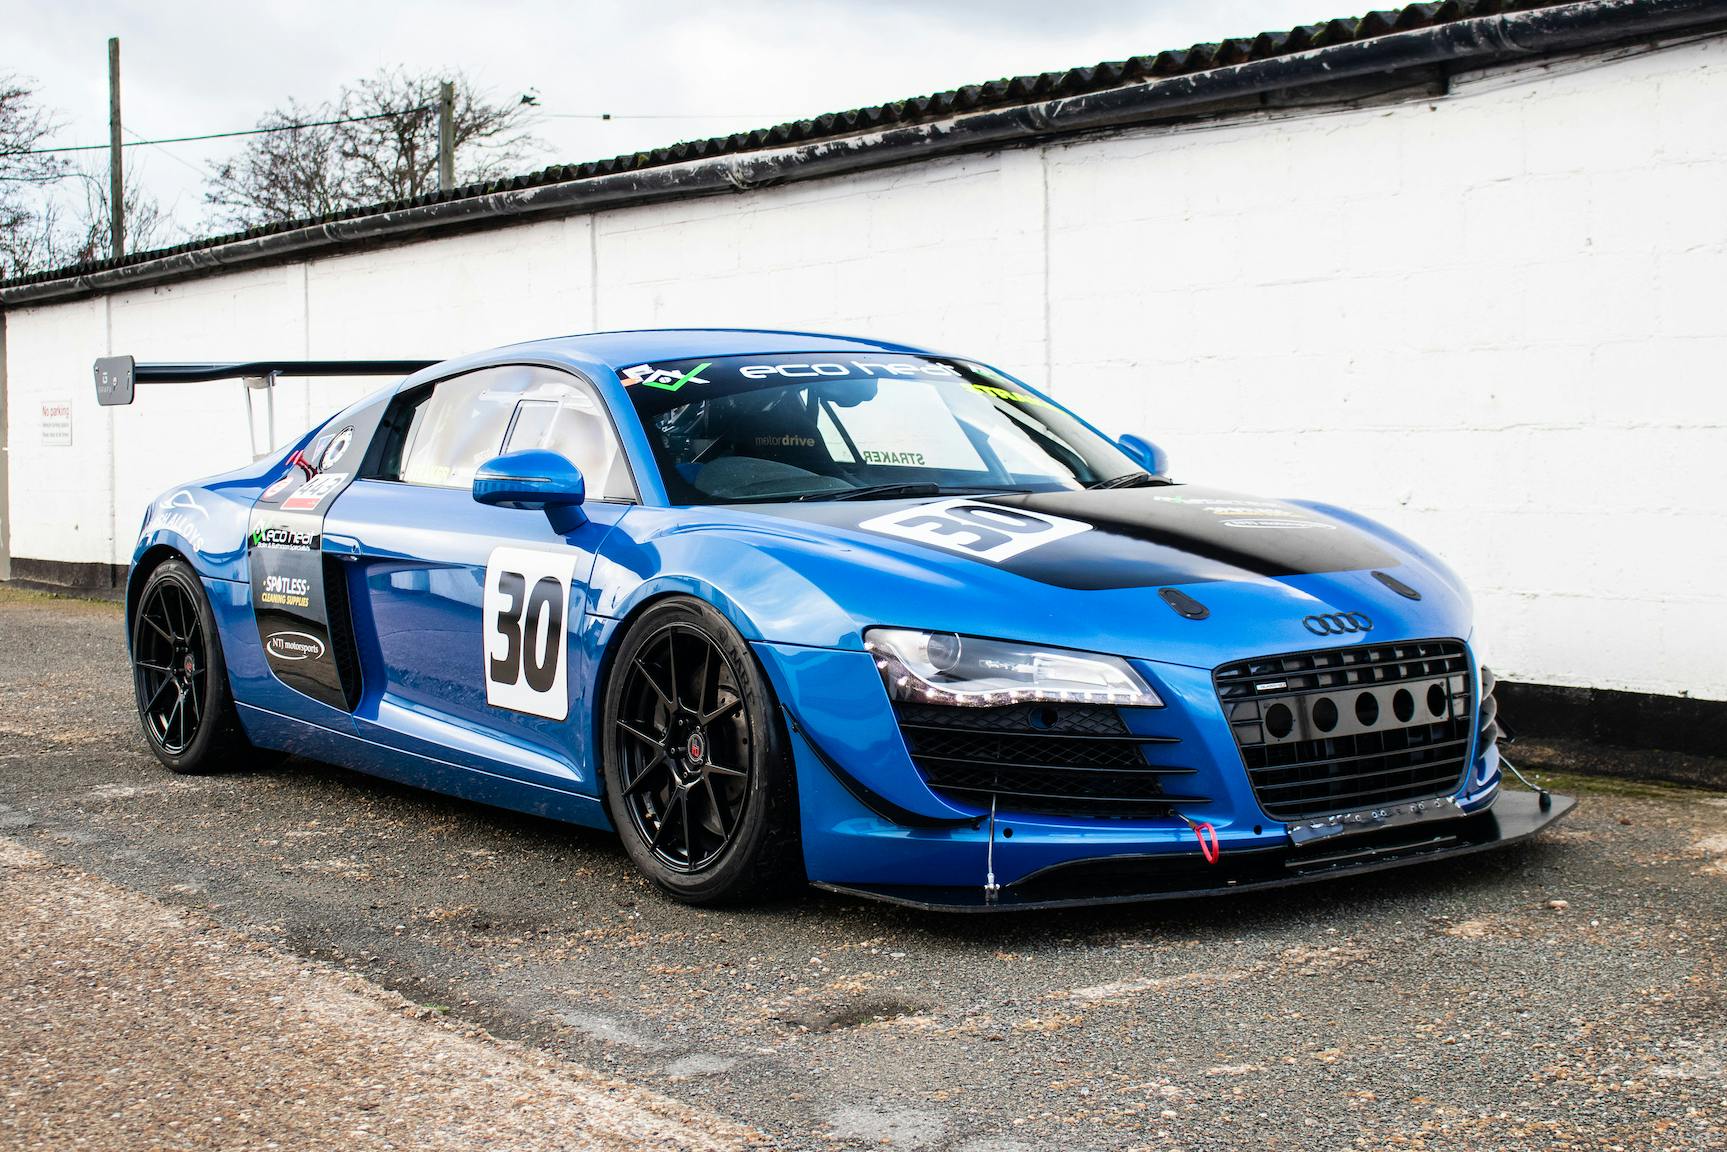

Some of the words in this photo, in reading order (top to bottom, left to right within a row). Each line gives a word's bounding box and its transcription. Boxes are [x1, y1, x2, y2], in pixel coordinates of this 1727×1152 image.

[739, 361, 850, 379] eco
[850, 360, 962, 379] heat
[266, 529, 287, 543] eco
[287, 529, 316, 545] heat
[895, 505, 1054, 553] 30
[261, 592, 287, 605] CLEANING
[286, 595, 309, 608] SUPPLIES
[489, 570, 564, 693] 30
[272, 637, 284, 649] NTJ
[284, 641, 319, 655] motorsports
